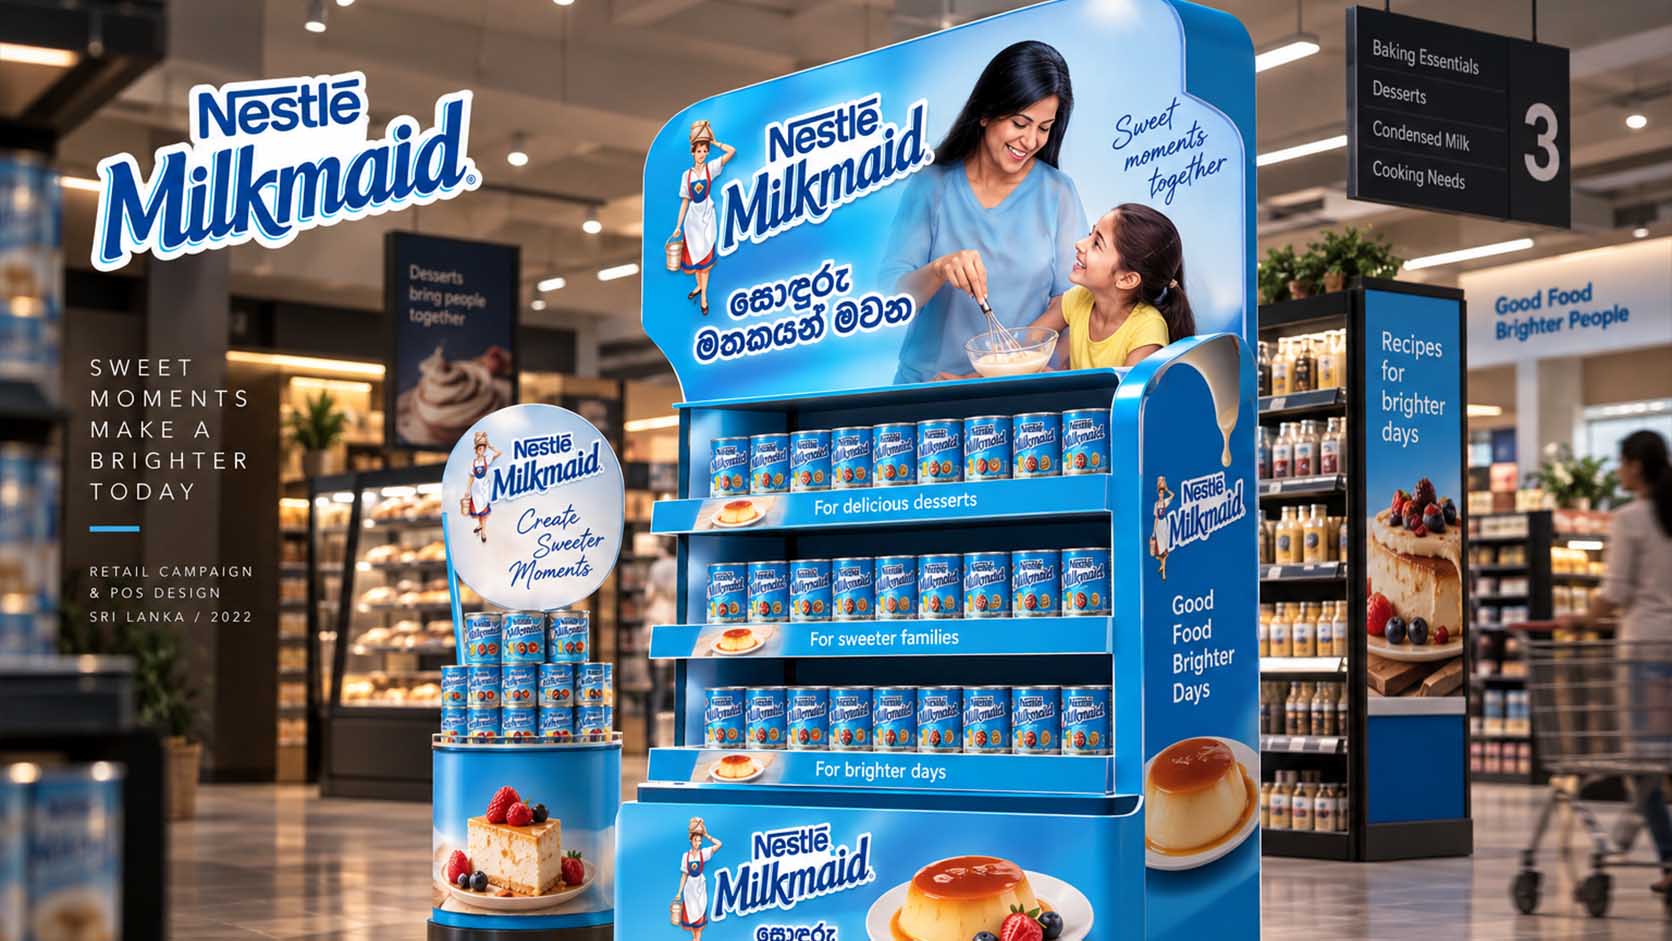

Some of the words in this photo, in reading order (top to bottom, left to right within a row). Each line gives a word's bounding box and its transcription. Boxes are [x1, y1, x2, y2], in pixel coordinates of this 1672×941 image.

[1373, 40, 1415, 67] Baking
[1420, 48, 1480, 75] Essentials
[1373, 80, 1426, 105] Desserts
[1112, 97, 1180, 150] Sweet
[1373, 120, 1442, 147] Condensed
[1446, 132, 1470, 152] Milk
[1124, 120, 1208, 172] moments
[1524, 102, 1560, 182] 3
[724, 105, 925, 249] Milkmaid
[1148, 152, 1227, 206] together
[1373, 160, 1424, 188] Cooking
[1428, 170, 1466, 190] Needs
[410, 264, 464, 285] Desserts
[410, 286, 442, 306] bring
[444, 292, 487, 310] people
[1496, 290, 1541, 315] Good
[1549, 282, 1592, 308] Food
[410, 308, 465, 327] together
[696, 304, 824, 360] මතකයන්
[835, 296, 912, 332] මවන
[1496, 316, 1562, 341] Brighter
[1569, 304, 1629, 331] People
[1382, 331, 1442, 360] Recipes
[1382, 360, 1405, 382] for
[1382, 390, 1445, 418] brighter
[1382, 421, 1420, 448] days
[492, 442, 601, 502] Milkmaid
[516, 504, 580, 534] Create
[815, 500, 838, 516] For
[844, 494, 908, 514] delicious
[914, 492, 978, 510] desserts
[1169, 482, 1242, 548] Milkmaid
[533, 528, 604, 558] Sweeter
[509, 556, 592, 590] Moments
[1172, 588, 1214, 615] Good
[810, 632, 834, 646] For
[838, 632, 896, 646] sweeter
[901, 630, 960, 644] families
[1173, 618, 1212, 645] Food
[1173, 648, 1235, 675] Brighter
[1174, 683, 1210, 705] Days
[816, 760, 840, 777] For
[845, 762, 906, 782] brighter
[911, 763, 946, 782] days
[714, 836, 869, 918] Milkmaid
